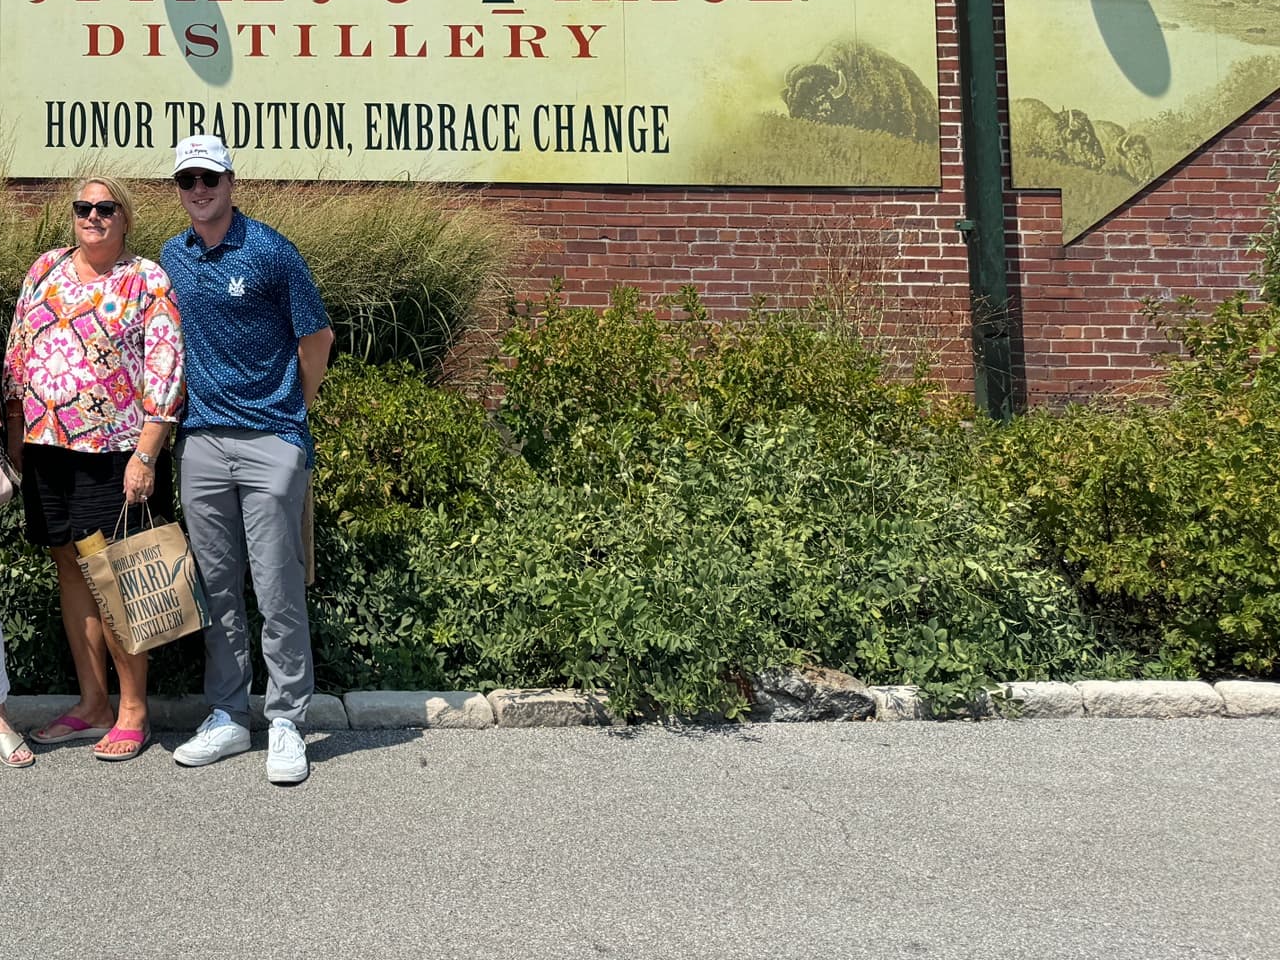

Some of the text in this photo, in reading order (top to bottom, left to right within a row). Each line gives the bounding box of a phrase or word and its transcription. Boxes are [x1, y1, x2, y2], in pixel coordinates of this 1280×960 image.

[81, 23, 607, 58] DISTILLERY
[44, 100, 670, 155] HONOR TRADITION, EMBRACE CHANGE
[112, 544, 162, 572] WORLD'S MOST
[119, 559, 172, 603] AWARD
[124, 587, 180, 625] WINNING
[131, 608, 184, 643] DISTILLERY
